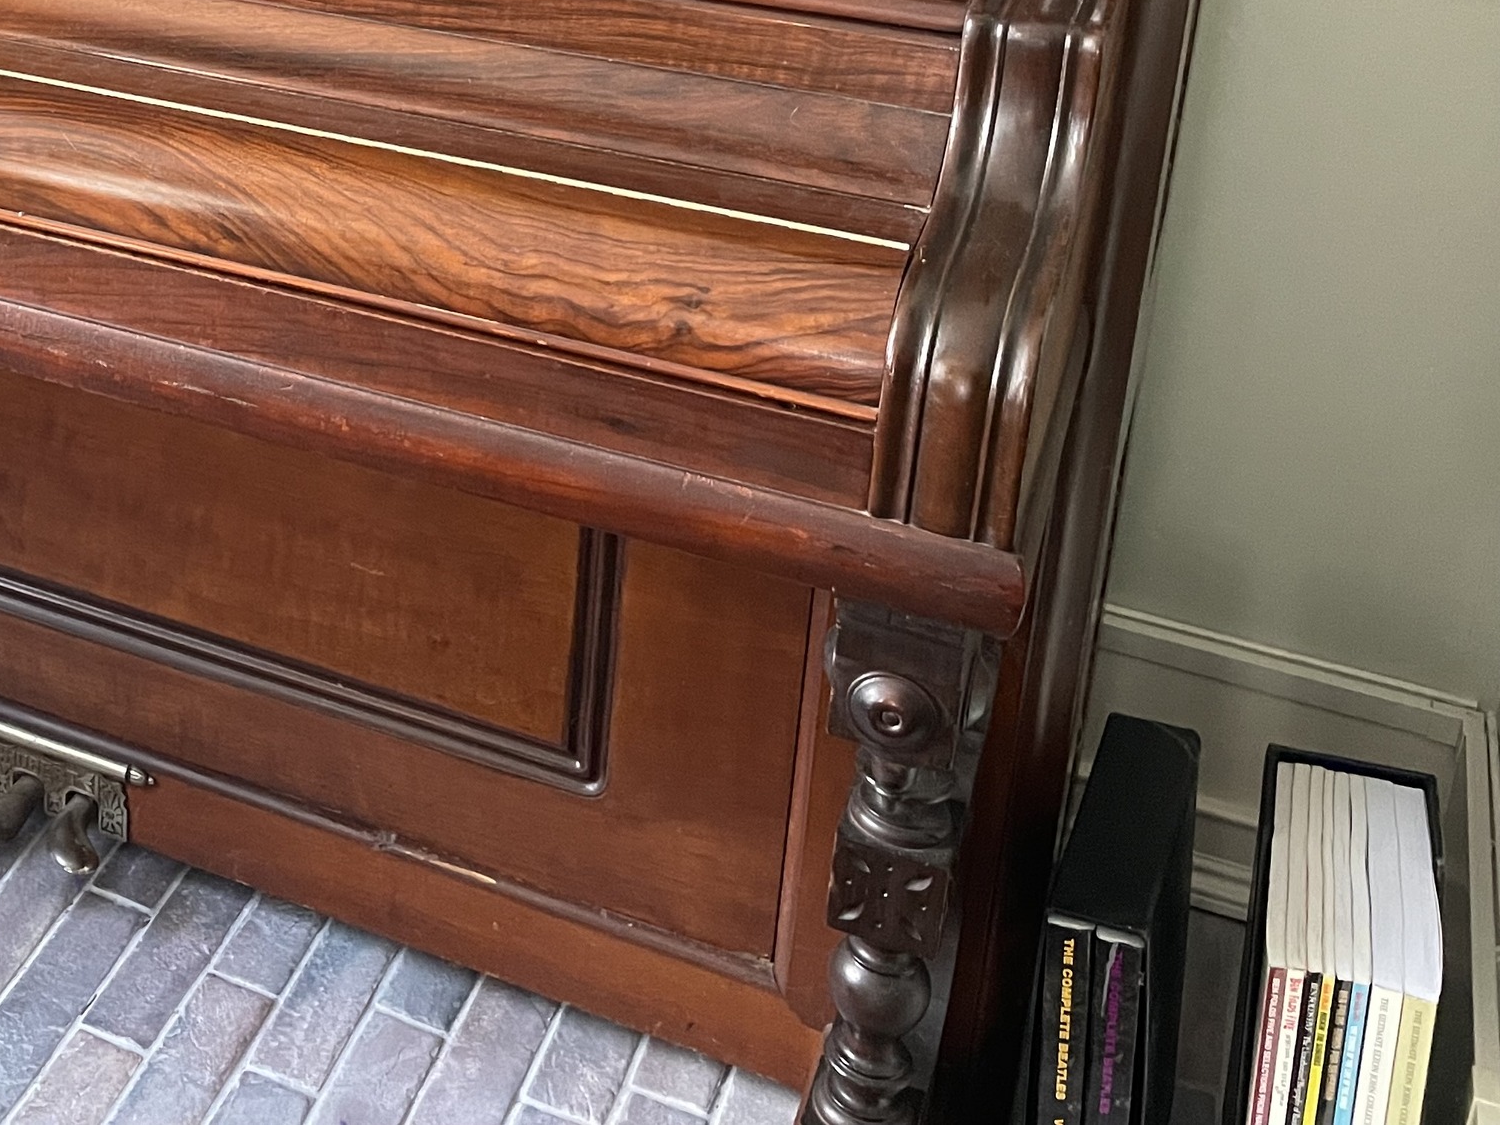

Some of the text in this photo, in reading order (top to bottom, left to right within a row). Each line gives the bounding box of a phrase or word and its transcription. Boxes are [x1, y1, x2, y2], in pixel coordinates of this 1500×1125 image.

[1055, 938, 1075, 1100] THE COMPLETE BEATLES
[1105, 981, 1120, 1053] COMPLETE
[1380, 997, 1389, 1012] THE
[1375, 1013, 1386, 1048] ULTIMATE
[1371, 1049, 1381, 1072] ELTON
[1100, 1057, 1114, 1114] BEATLES
[1367, 1073, 1377, 1095] JOHN
